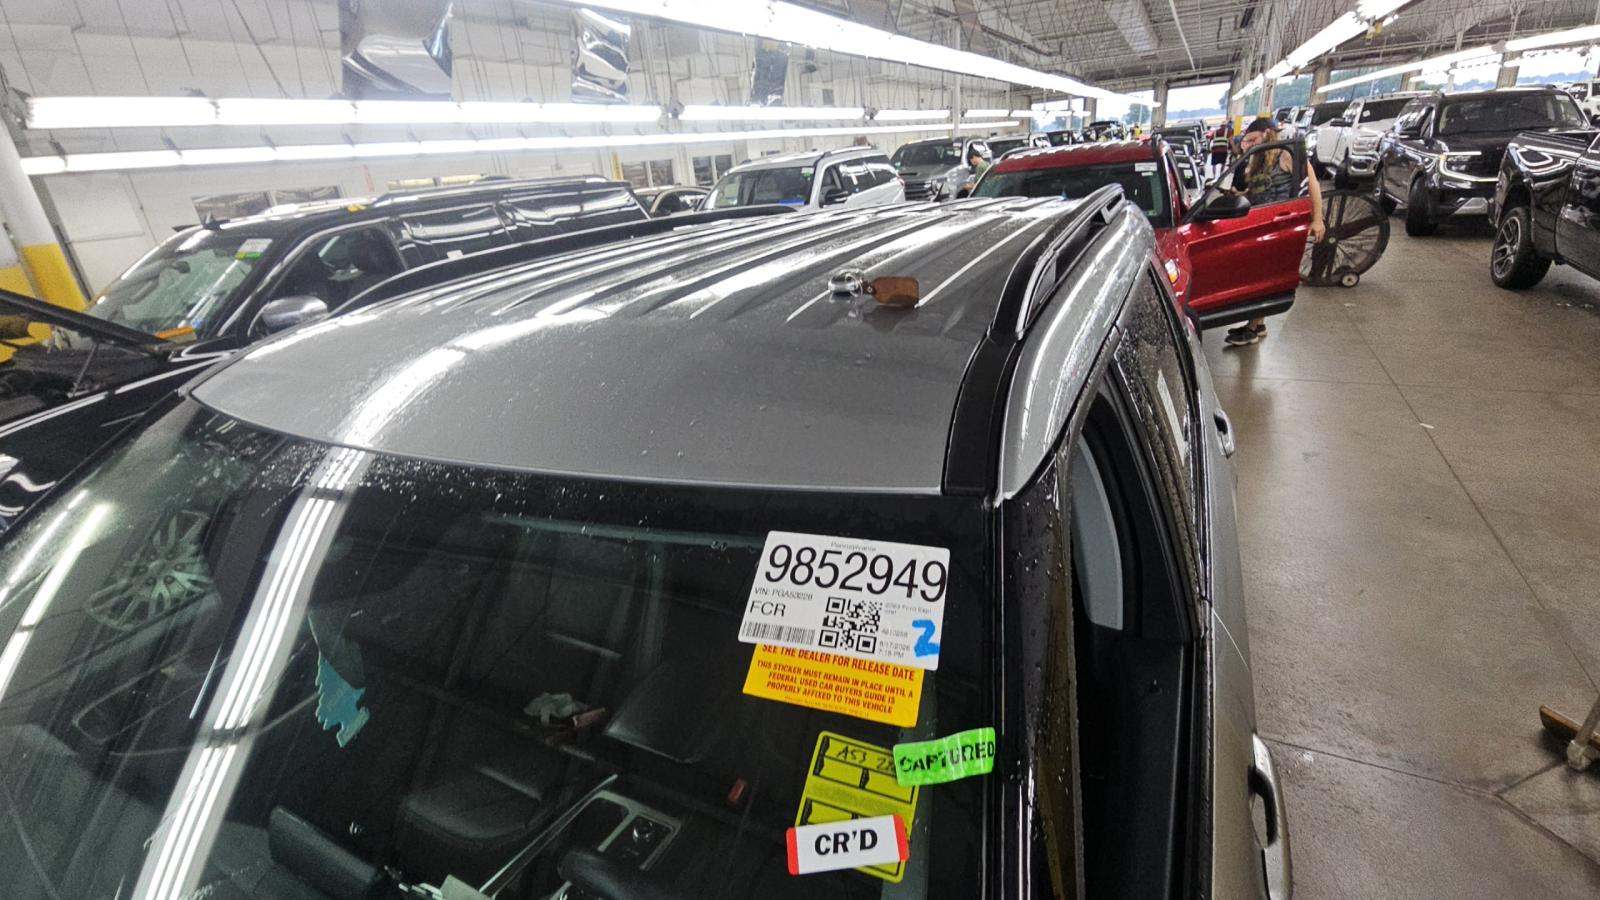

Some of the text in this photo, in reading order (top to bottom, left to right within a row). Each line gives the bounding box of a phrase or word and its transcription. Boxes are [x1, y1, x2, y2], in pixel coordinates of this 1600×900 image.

[765, 544, 947, 602] 9852949
[750, 600, 786, 617] FCR
[912, 619, 940, 657] 2
[757, 660, 772, 669] THIS
[773, 663, 801, 674] STICKER
[802, 669, 821, 679] MUST
[823, 672, 850, 683] REMAIN
[851, 677, 860, 686] IN
[860, 680, 883, 691] PLACE
[885, 685, 906, 697] UNTIL
[762, 644, 915, 681] SEE THE DEALER FOR RELEASE DATE
[767, 681, 800, 694] PROPERLY
[802, 688, 831, 700] AFFIXED
[833, 694, 843, 703] TO
[845, 696, 861, 706] THIS
[862, 701, 893, 713] VEHICLE
[768, 671, 895, 704] FEDERAL USED CAR BUYERS GUIDE IS
[900, 741, 995, 773] CAPTURED
